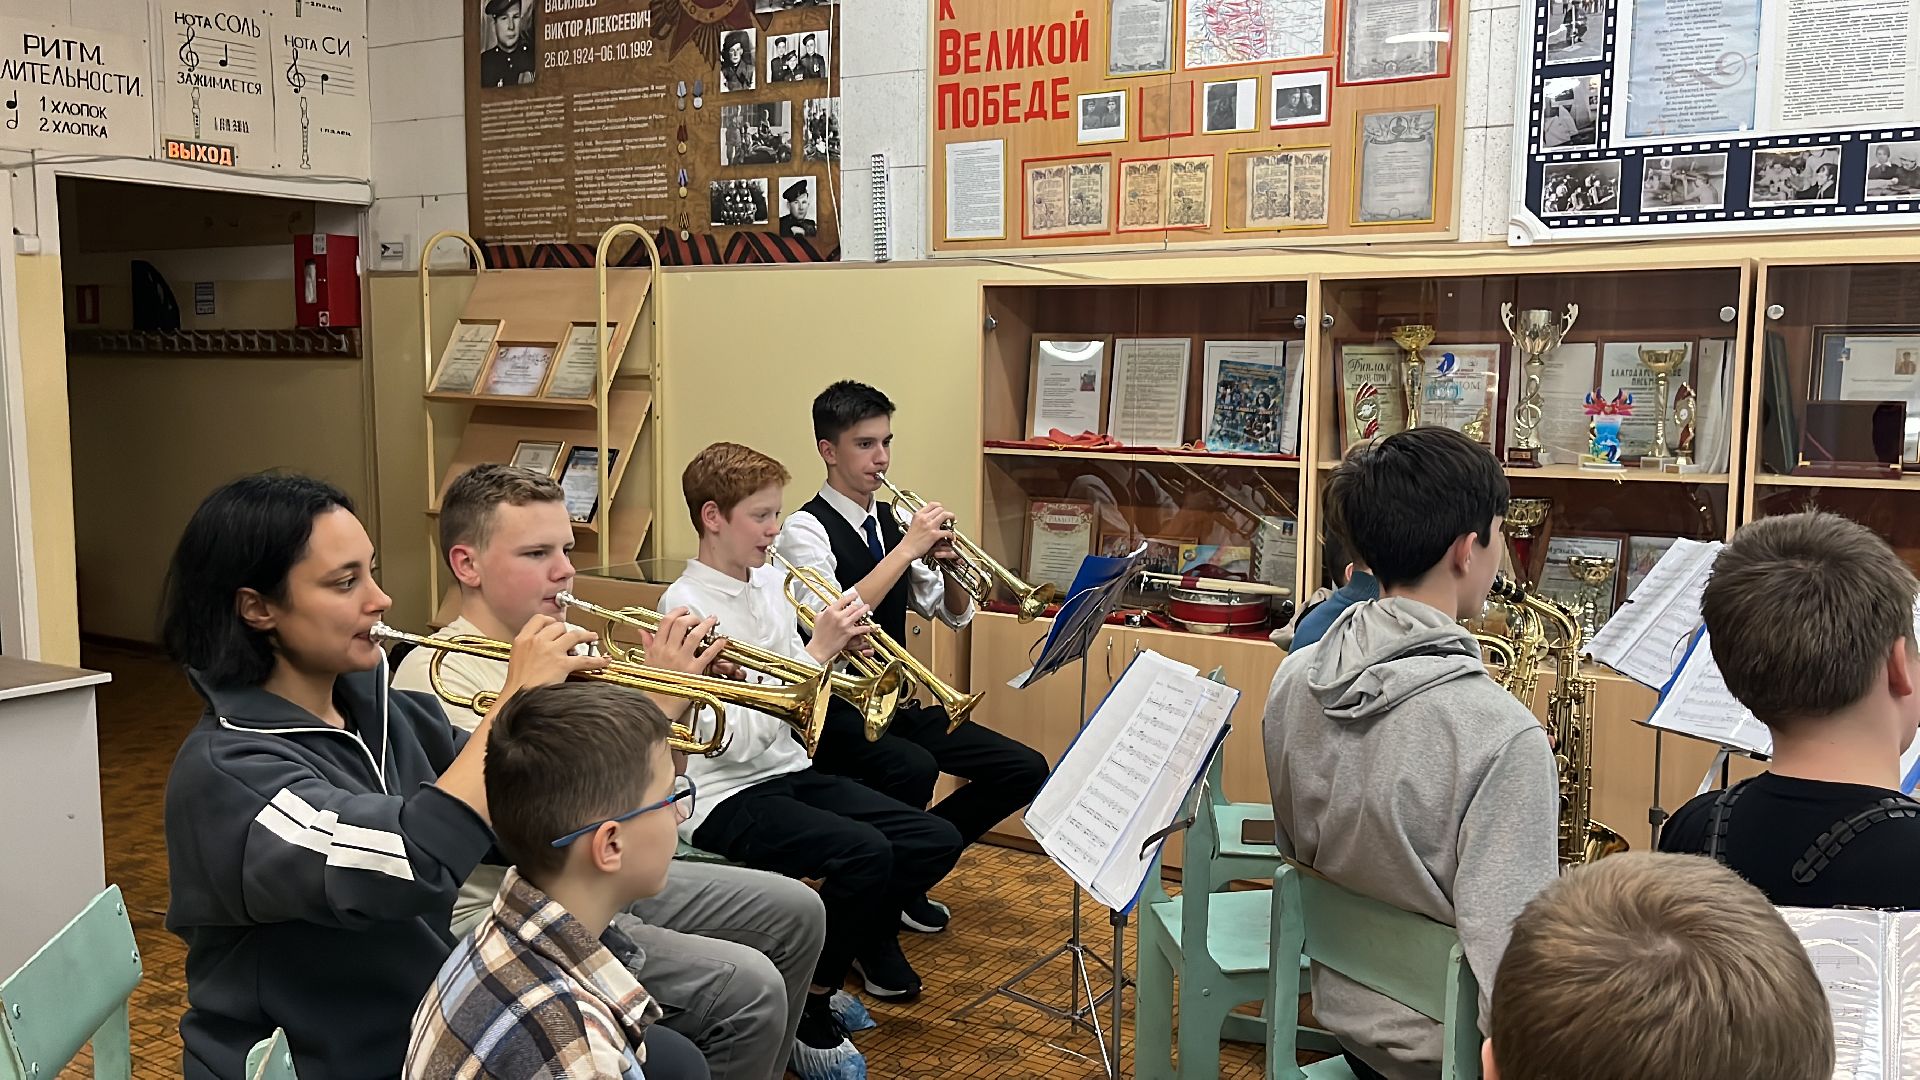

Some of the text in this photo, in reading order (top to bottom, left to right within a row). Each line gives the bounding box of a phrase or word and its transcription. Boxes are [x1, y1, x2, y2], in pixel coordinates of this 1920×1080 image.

[174, 11, 262, 39] НОТА СОЛЬ
[544, 10, 651, 41] ВИКТОР АЛЕКСЕЕВИЧ
[23, 33, 105, 66] РИТМ.
[284, 34, 351, 59] НОТА СИ
[938, 10, 1089, 76] ВЕЛИКОЙ
[0, 59, 144, 97] ЛИТЕЛЬНОСТИ.
[177, 71, 263, 96] ЗАЖИМАЕТСЯ
[40, 95, 108, 120] 1 ХЛОПОК
[938, 77, 1070, 130] ПОБЕДЕ
[39, 117, 108, 139] 2 ХЛОПКА
[168, 141, 233, 167] ВЫХОД
